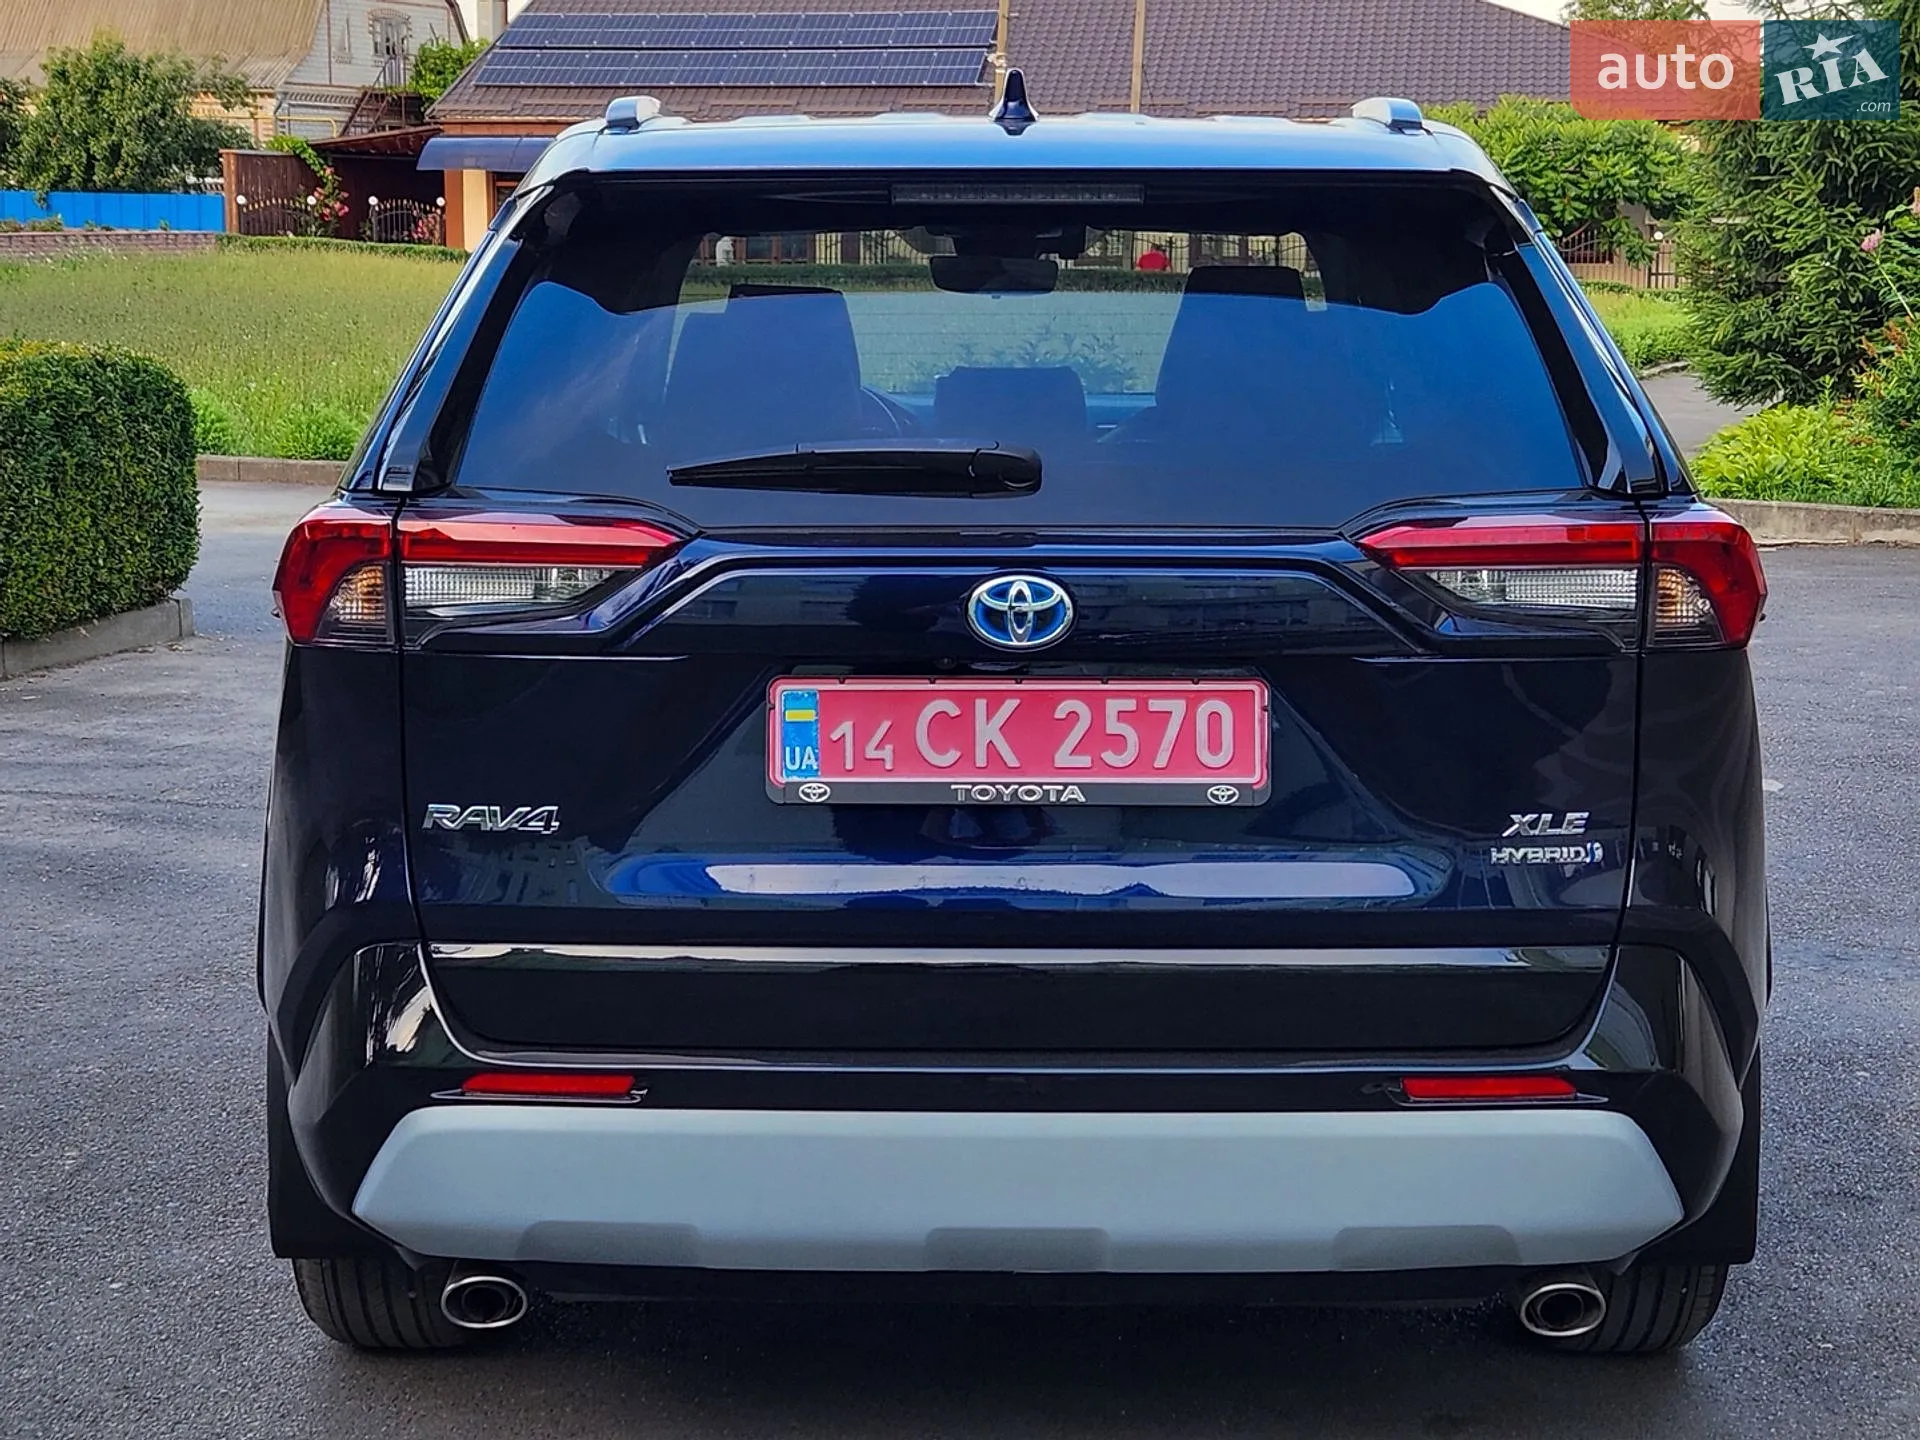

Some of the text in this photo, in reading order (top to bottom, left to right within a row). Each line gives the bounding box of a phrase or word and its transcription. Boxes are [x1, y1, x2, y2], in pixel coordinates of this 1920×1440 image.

[830, 698, 1234, 770] 14 CK 2570
[785, 746, 818, 770] UA
[951, 784, 1086, 802] TOYOTA
[422, 804, 560, 834] RAV4
[1502, 812, 1589, 837] XLE
[1490, 846, 1588, 864] HYBRID
